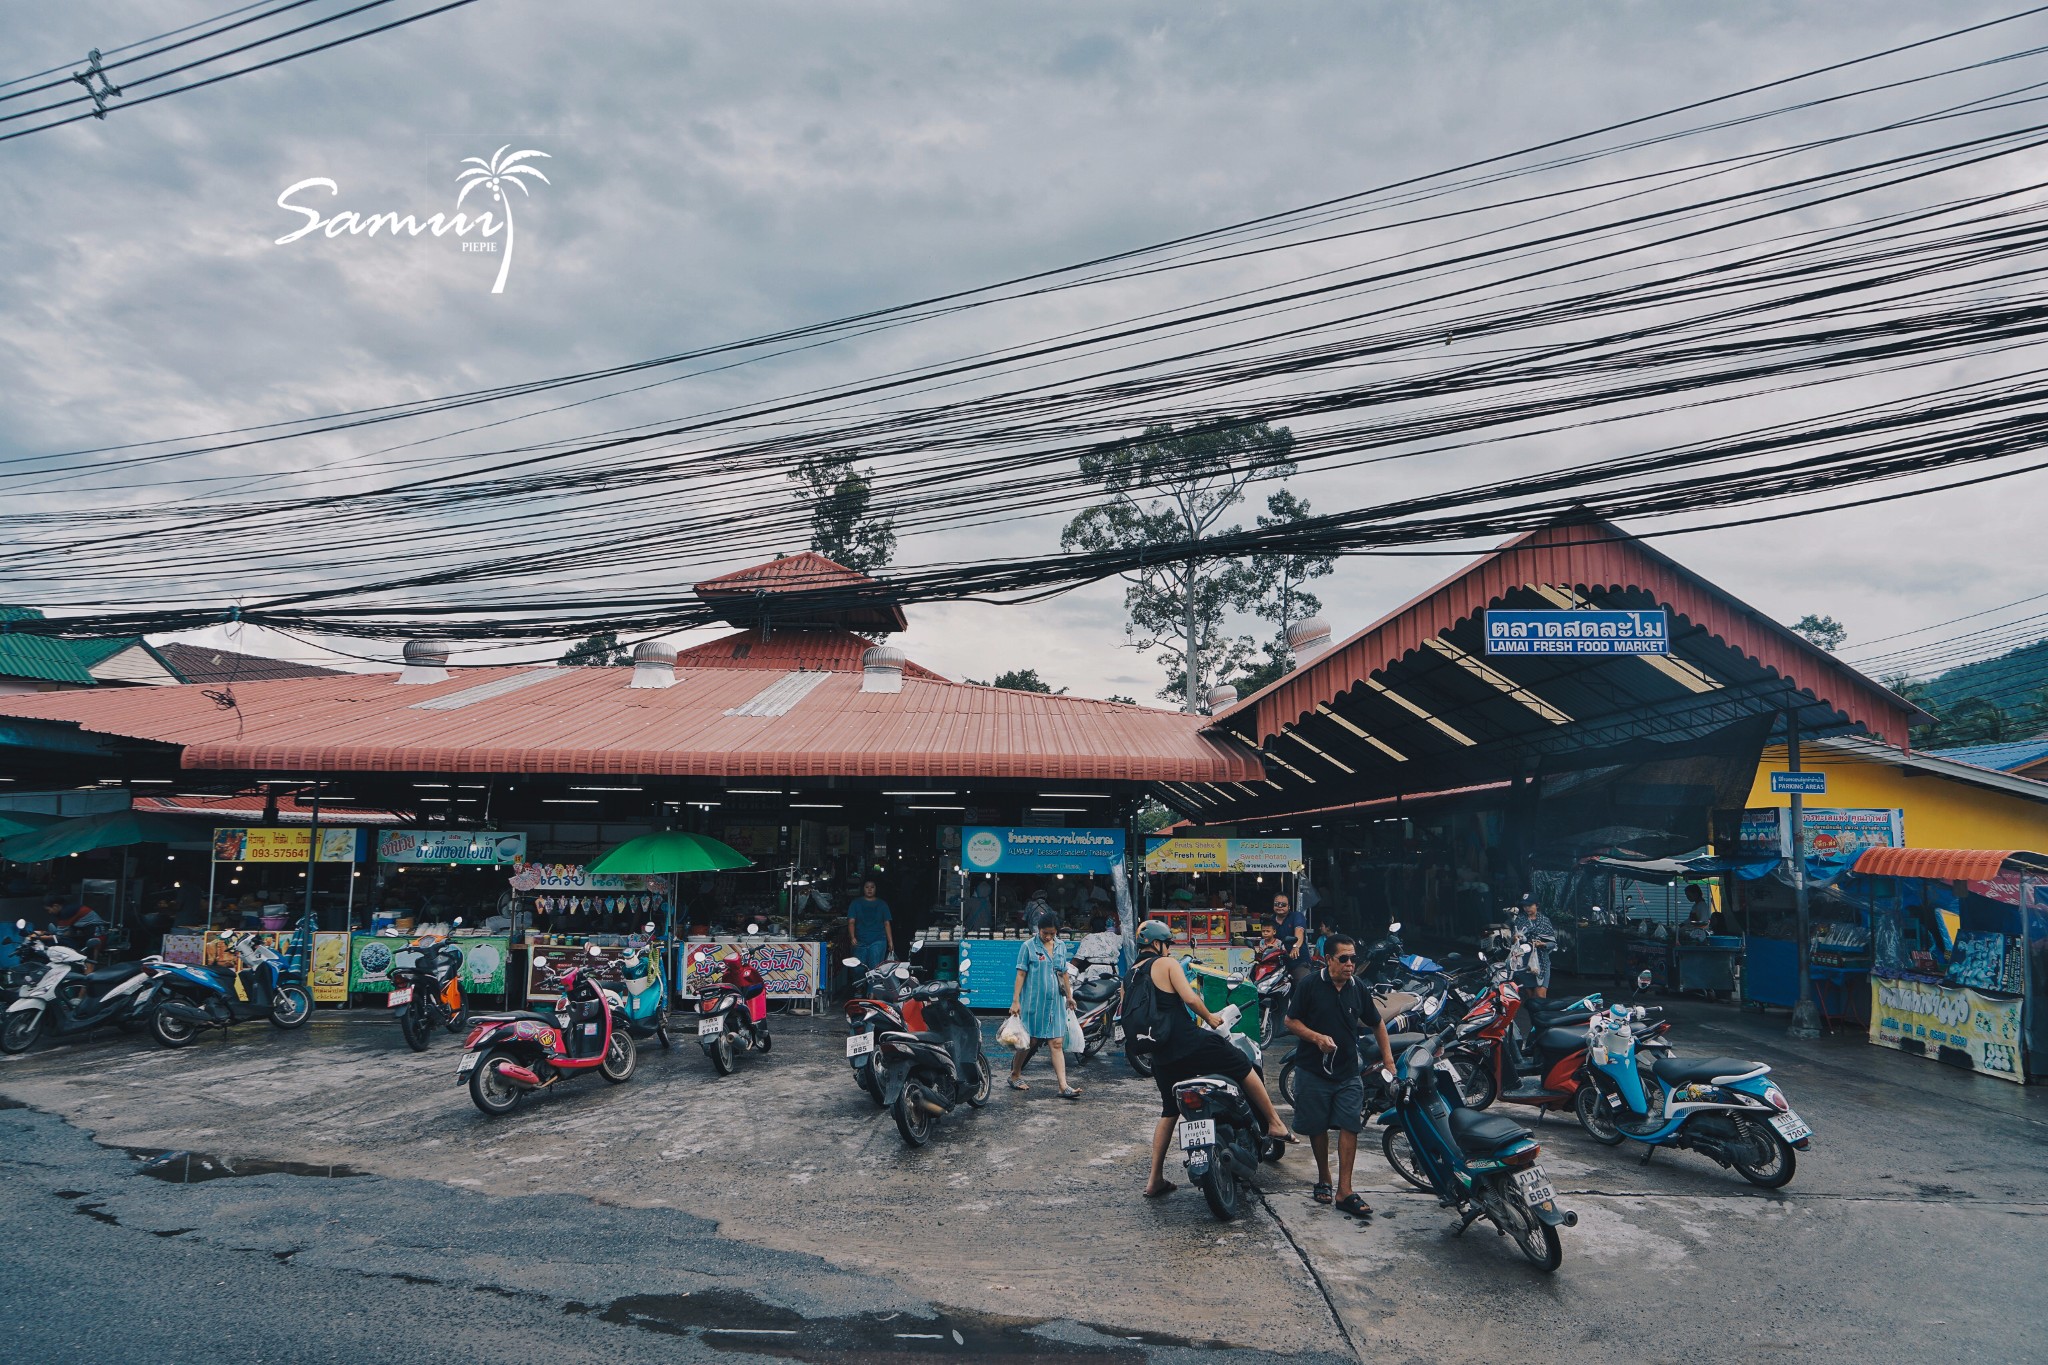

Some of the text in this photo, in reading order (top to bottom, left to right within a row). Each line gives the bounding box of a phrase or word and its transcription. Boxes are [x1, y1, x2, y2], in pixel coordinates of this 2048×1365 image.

[1491, 612, 1662, 637] ตลาดสดละไม
[1490, 640, 1665, 652] LAMAI FRESH FOOD MARKET
[1851, 812, 1888, 825] คุณภาพดี
[1174, 841, 1193, 849] Fruits
[1195, 841, 1215, 849] Shake
[1240, 841, 1290, 849] Fried Banana
[1037, 848, 1064, 857] Dessert
[1786, 1127, 1808, 1140] 7204
[1188, 1136, 1206, 1147] 641
[1528, 1187, 1551, 1203] 688
